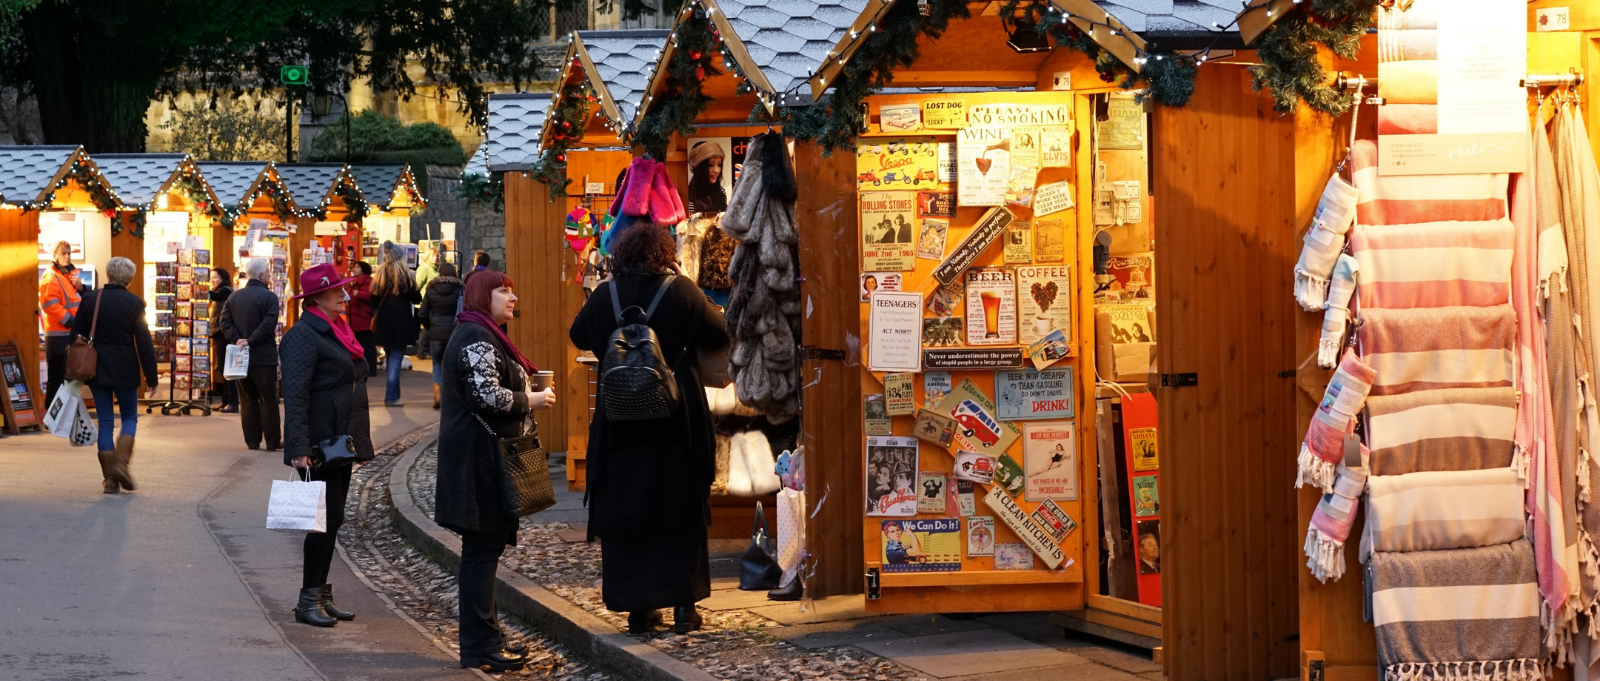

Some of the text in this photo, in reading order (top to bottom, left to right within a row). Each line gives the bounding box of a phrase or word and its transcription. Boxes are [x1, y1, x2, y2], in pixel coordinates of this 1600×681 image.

[1556, 14, 1566, 24] 78
[972, 107, 1066, 124] NO SMOKING
[964, 128, 1006, 140] WINE
[1043, 152, 1068, 160] ELVIS
[879, 153, 914, 172] Vespa
[1045, 182, 1066, 191] MOTHER
[862, 200, 912, 210] ROLLING STONES
[944, 265, 952, 274] am
[967, 233, 985, 248] Nobody
[954, 252, 976, 273] Therefore
[978, 242, 986, 250] am
[1108, 258, 1150, 270] Rowntree's
[969, 273, 1012, 281] BEER
[1020, 268, 1066, 278] COFFEE
[1036, 381, 1063, 389] GASOLINE
[962, 382, 985, 402] LEGEND
[984, 400, 995, 411] ON
[1032, 399, 1069, 412] DRINK!
[880, 487, 917, 514] Casablanca
[1045, 500, 1068, 523] ICE COLD
[902, 520, 959, 530] We Can Do It!
[994, 490, 1002, 499] A
[1001, 496, 1026, 522] CLEAN
[1023, 518, 1056, 552] KITCHEN
[1052, 548, 1063, 560] IS
[1034, 514, 1055, 534] SOLD HERE
[1034, 545, 1042, 554] life
